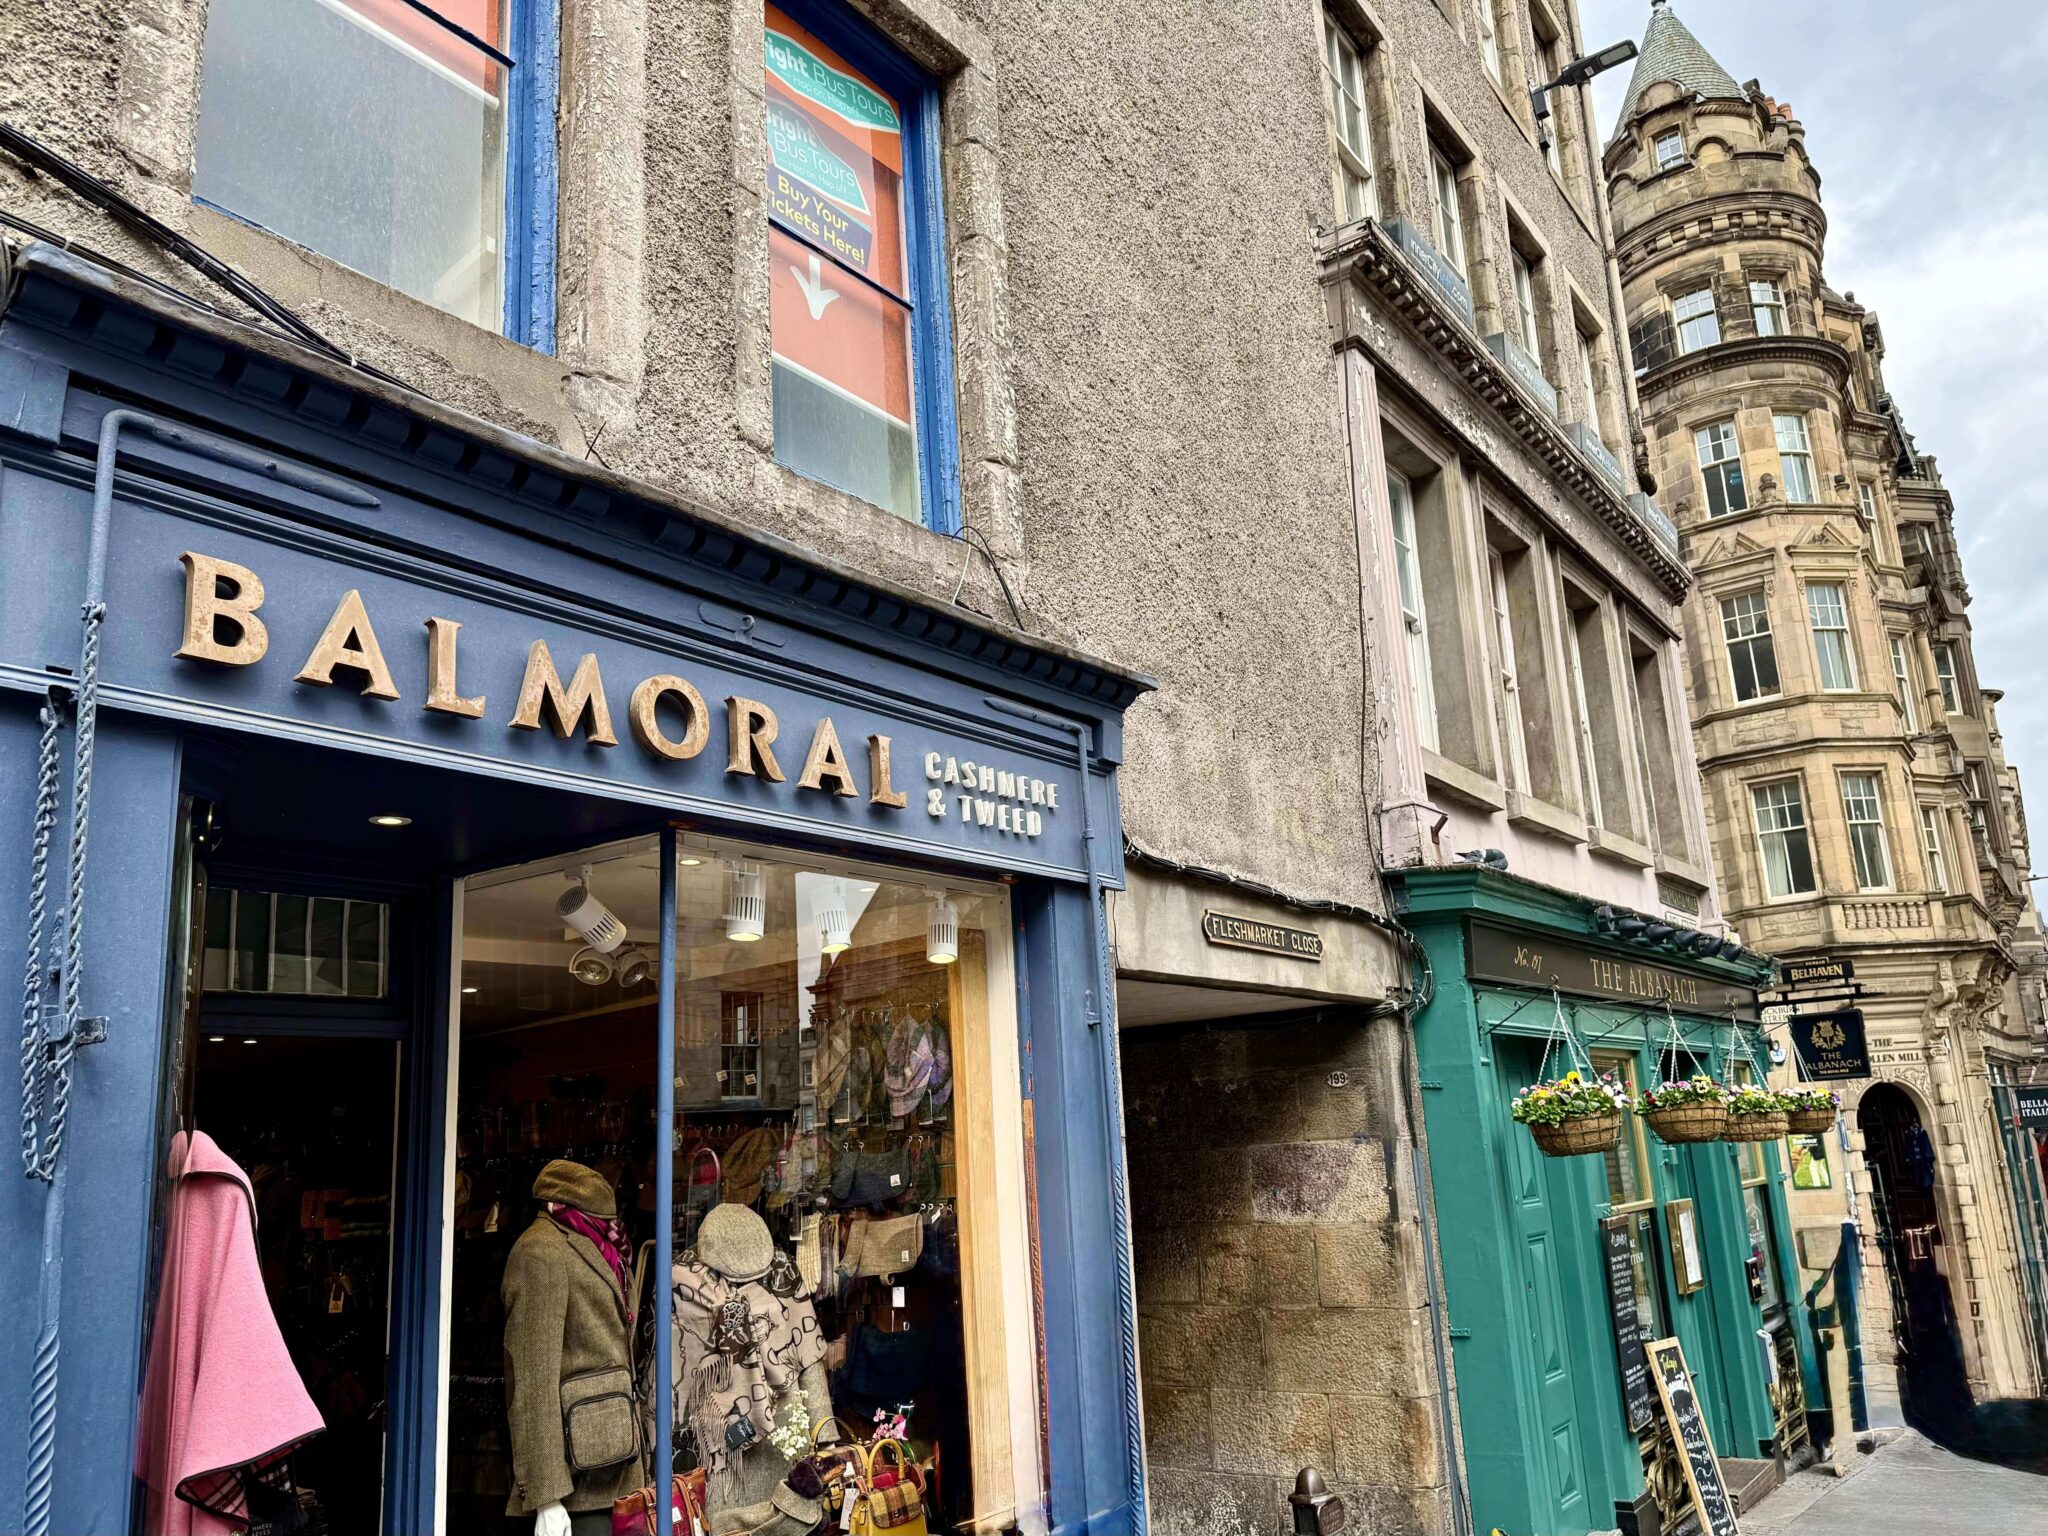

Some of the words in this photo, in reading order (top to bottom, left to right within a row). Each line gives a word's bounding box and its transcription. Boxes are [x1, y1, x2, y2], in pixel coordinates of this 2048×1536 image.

[765, 37, 809, 78] ight
[812, 62, 846, 98] Bus
[847, 82, 894, 124] Tours
[774, 131, 808, 164] Bus
[808, 146, 856, 187] Tours
[778, 174, 810, 211] Buy
[812, 196, 849, 232] Your
[824, 225, 866, 265] Here!
[171, 550, 909, 810] BALMORAL
[924, 751, 1060, 810] CASHMERE
[926, 787, 948, 818] &
[957, 794, 1043, 838] TWEED
[1212, 917, 1286, 948] FLESHMARKET
[1291, 932, 1321, 954] CLOSE
[1590, 958, 1623, 992] THE
[1629, 966, 1699, 1005] ALBANACH
[1790, 964, 1844, 981] BELHAVEN
[1820, 1051, 1843, 1060] THE
[1871, 1038, 1893, 1048] THE
[1898, 1052, 1923, 1061] MILL
[1329, 1073, 1346, 1085] 199
[1806, 1059, 1862, 1070] ALBANACH
[2020, 1099, 2048, 1109] BELLA
